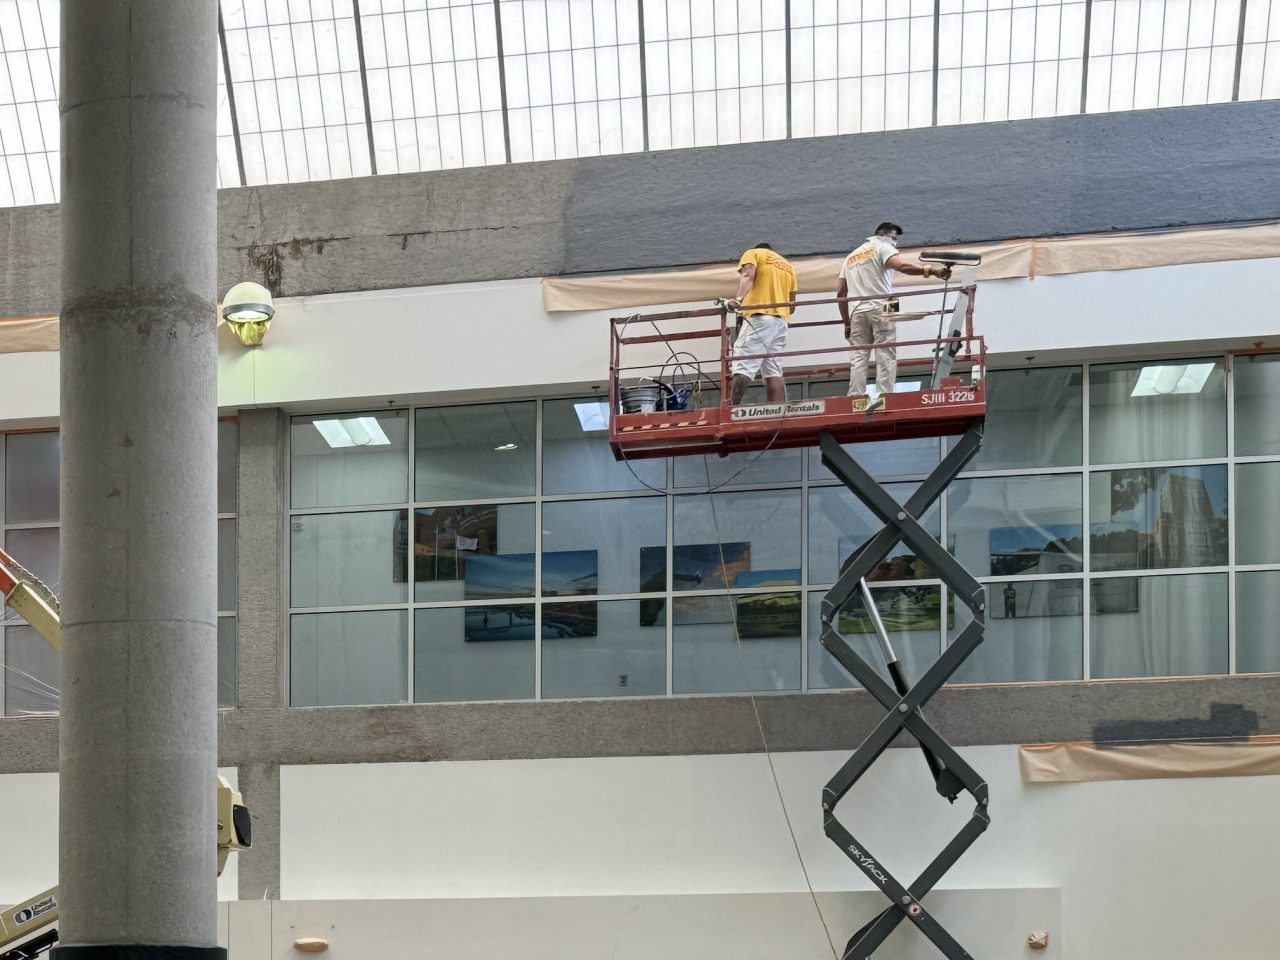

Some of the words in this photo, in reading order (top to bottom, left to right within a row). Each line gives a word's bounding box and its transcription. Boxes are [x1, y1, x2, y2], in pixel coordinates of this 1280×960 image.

[748, 406, 782, 417] United
[784, 403, 820, 413] Rentals
[848, 845, 888, 884] SKYJACK
